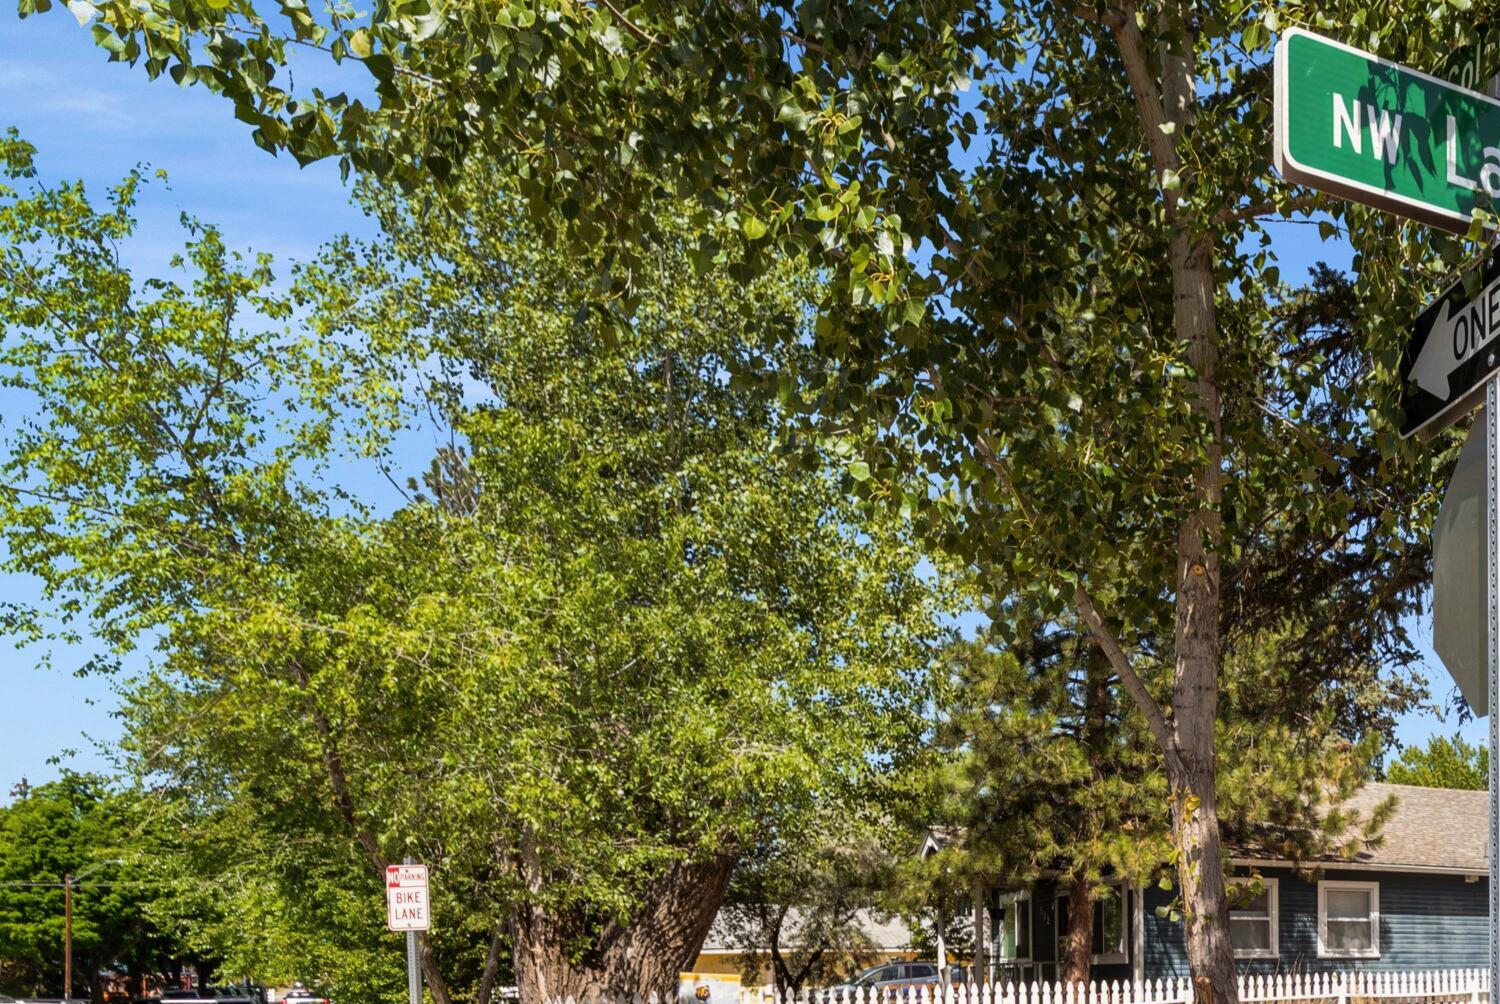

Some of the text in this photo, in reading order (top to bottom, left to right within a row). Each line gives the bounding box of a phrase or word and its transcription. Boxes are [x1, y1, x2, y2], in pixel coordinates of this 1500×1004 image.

[1332, 91, 1403, 166] NW
[388, 871, 425, 884] NO PARKING
[396, 891, 421, 904] BIKE
[395, 907, 422, 920] LANE
